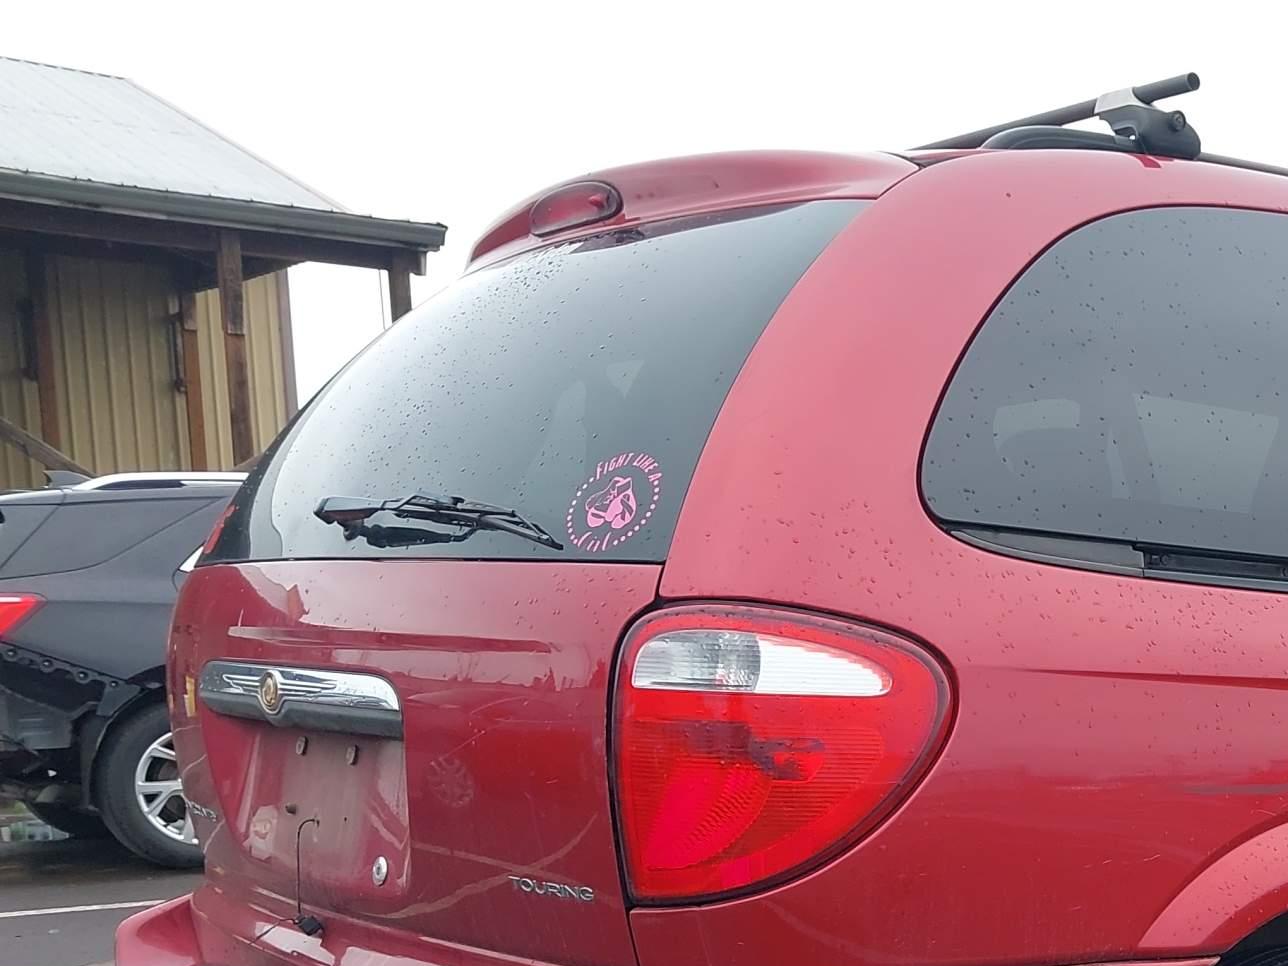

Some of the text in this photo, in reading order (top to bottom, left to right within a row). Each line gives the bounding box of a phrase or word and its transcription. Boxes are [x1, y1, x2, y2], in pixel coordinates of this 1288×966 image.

[596, 453, 634, 480] FIGHT
[632, 453, 659, 473] LIKE
[508, 875, 595, 901] TOURING
